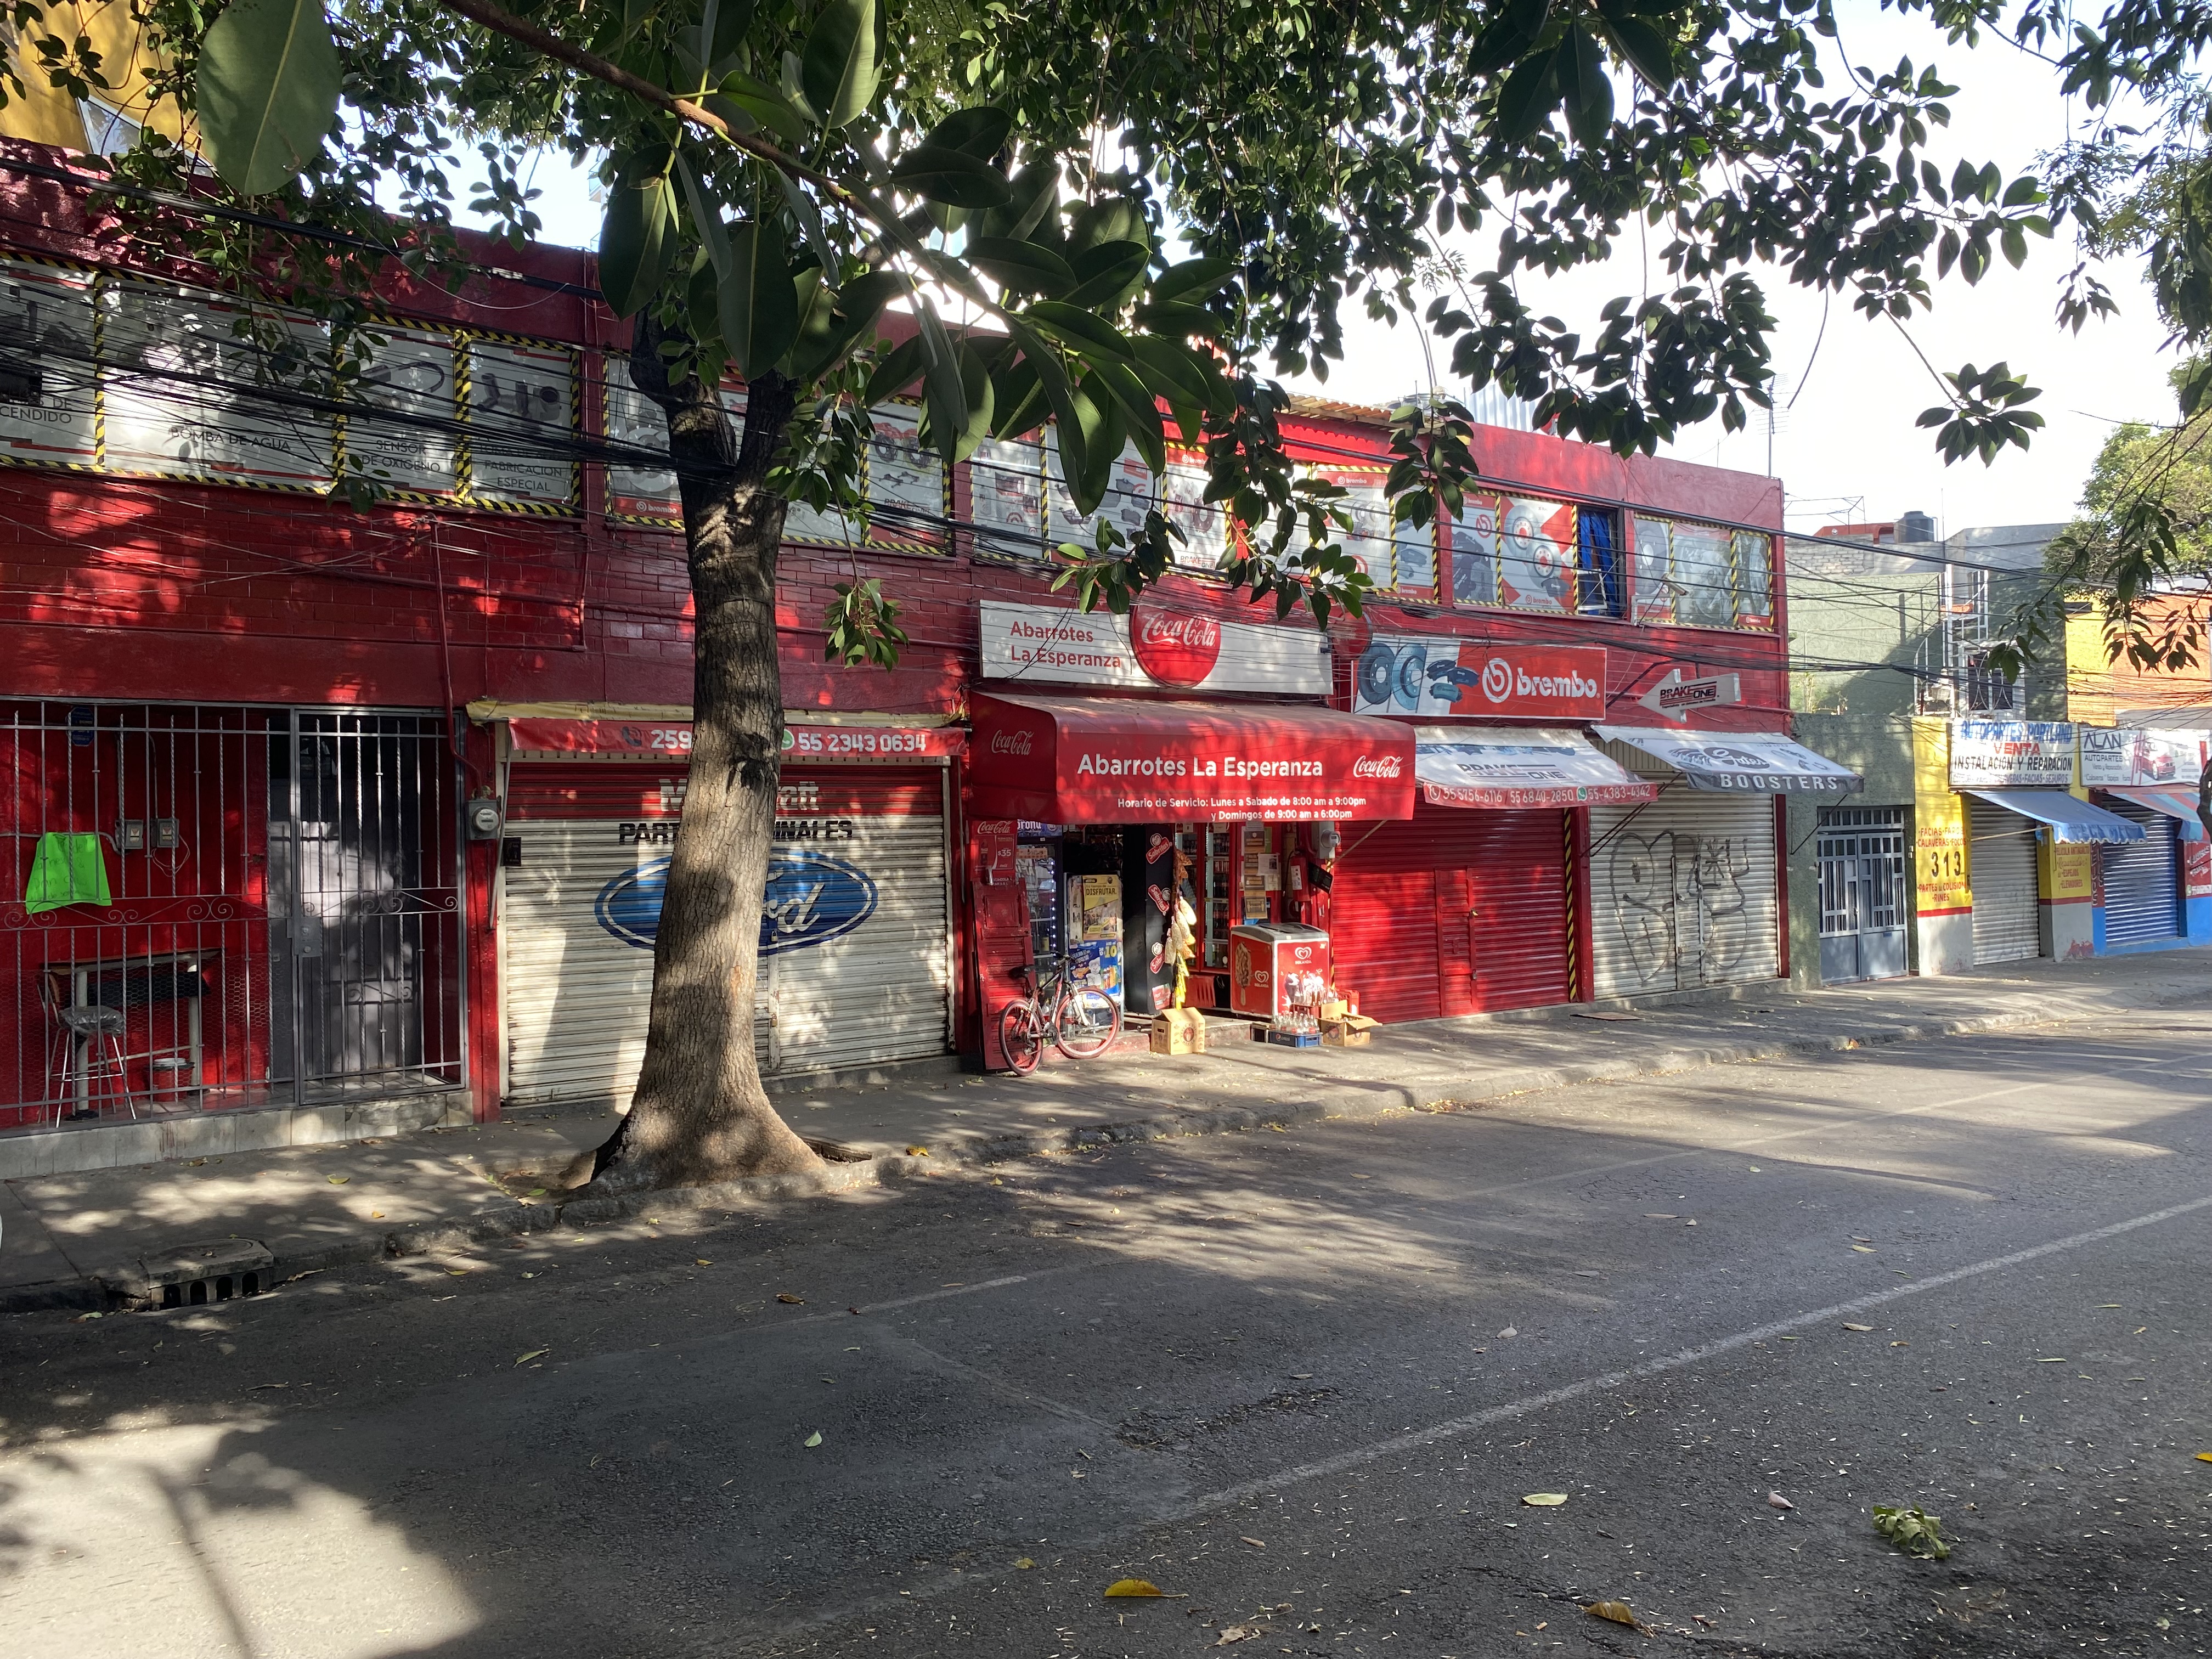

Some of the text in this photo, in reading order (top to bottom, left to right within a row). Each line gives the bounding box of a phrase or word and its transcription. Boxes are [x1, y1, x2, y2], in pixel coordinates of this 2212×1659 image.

[171, 428, 291, 450] BOMBA DE AGUA
[376, 440, 426, 455] SENSOR
[362, 455, 440, 472] DE OXIGENO
[1189, 456, 1206, 464] bremb
[497, 477, 551, 492] ESPECIAL
[1180, 555, 1201, 565] BRAKE
[1011, 621, 1093, 642] Abarrotes
[1141, 612, 1220, 647] Coca-Cola
[1011, 645, 1120, 668] La Esperanza
[1517, 667, 1597, 698] brembo
[1660, 686, 1716, 699] BRAKE ONE
[1961, 720, 2023, 742] AUTOPARTES
[798, 733, 823, 751] 55
[827, 733, 876, 752] 2343
[880, 734, 926, 752] 0634
[991, 729, 1034, 755] Coca-Cola
[2084, 732, 2122, 750] ALAN
[1994, 743, 2040, 757] VENTA
[1077, 753, 1404, 780] Abarrotes La Esperanza Coca-Cola
[1457, 763, 1567, 780] BRAKE ONE
[1954, 755, 2073, 771] INSTALACION Y REPARACION
[1720, 773, 1837, 791] BOOSTERS
[1118, 798, 1153, 808] Horario
[1155, 798, 1167, 808] de
[1170, 797, 1209, 808] Servicio:
[1210, 797, 1237, 807] Lunes
[1246, 797, 1278, 807] Sabado
[1280, 796, 1291, 806] de
[1293, 797, 1312, 806] 8:00
[1335, 797, 1367, 808] 9:00pm
[1443, 785, 1650, 804] 55 5756-6116 55 6840-2850 55-4383-4342
[1211, 812, 1216, 822] y
[1218, 810, 1262, 822] Domingos
[1264, 810, 1275, 819] de
[1277, 810, 1297, 819] 9:00
[1321, 810, 1352, 820] 6:00pm
[619, 822, 679, 845] PART
[977, 821, 1013, 834] Coca-Cola
[1921, 827, 1942, 837] FACIAS
[1148, 842, 1169, 860] Sabritas
[1917, 838, 1966, 848] CALAVERAS FOCOS
[1931, 851, 1961, 877] 313
[1086, 887, 1116, 896] DISFRUTAR
[1919, 883, 1938, 893] PARTES
[1943, 882, 1966, 891] COLISION
[1934, 893, 1950, 902] RINES
[1104, 945, 1117, 958] 10
